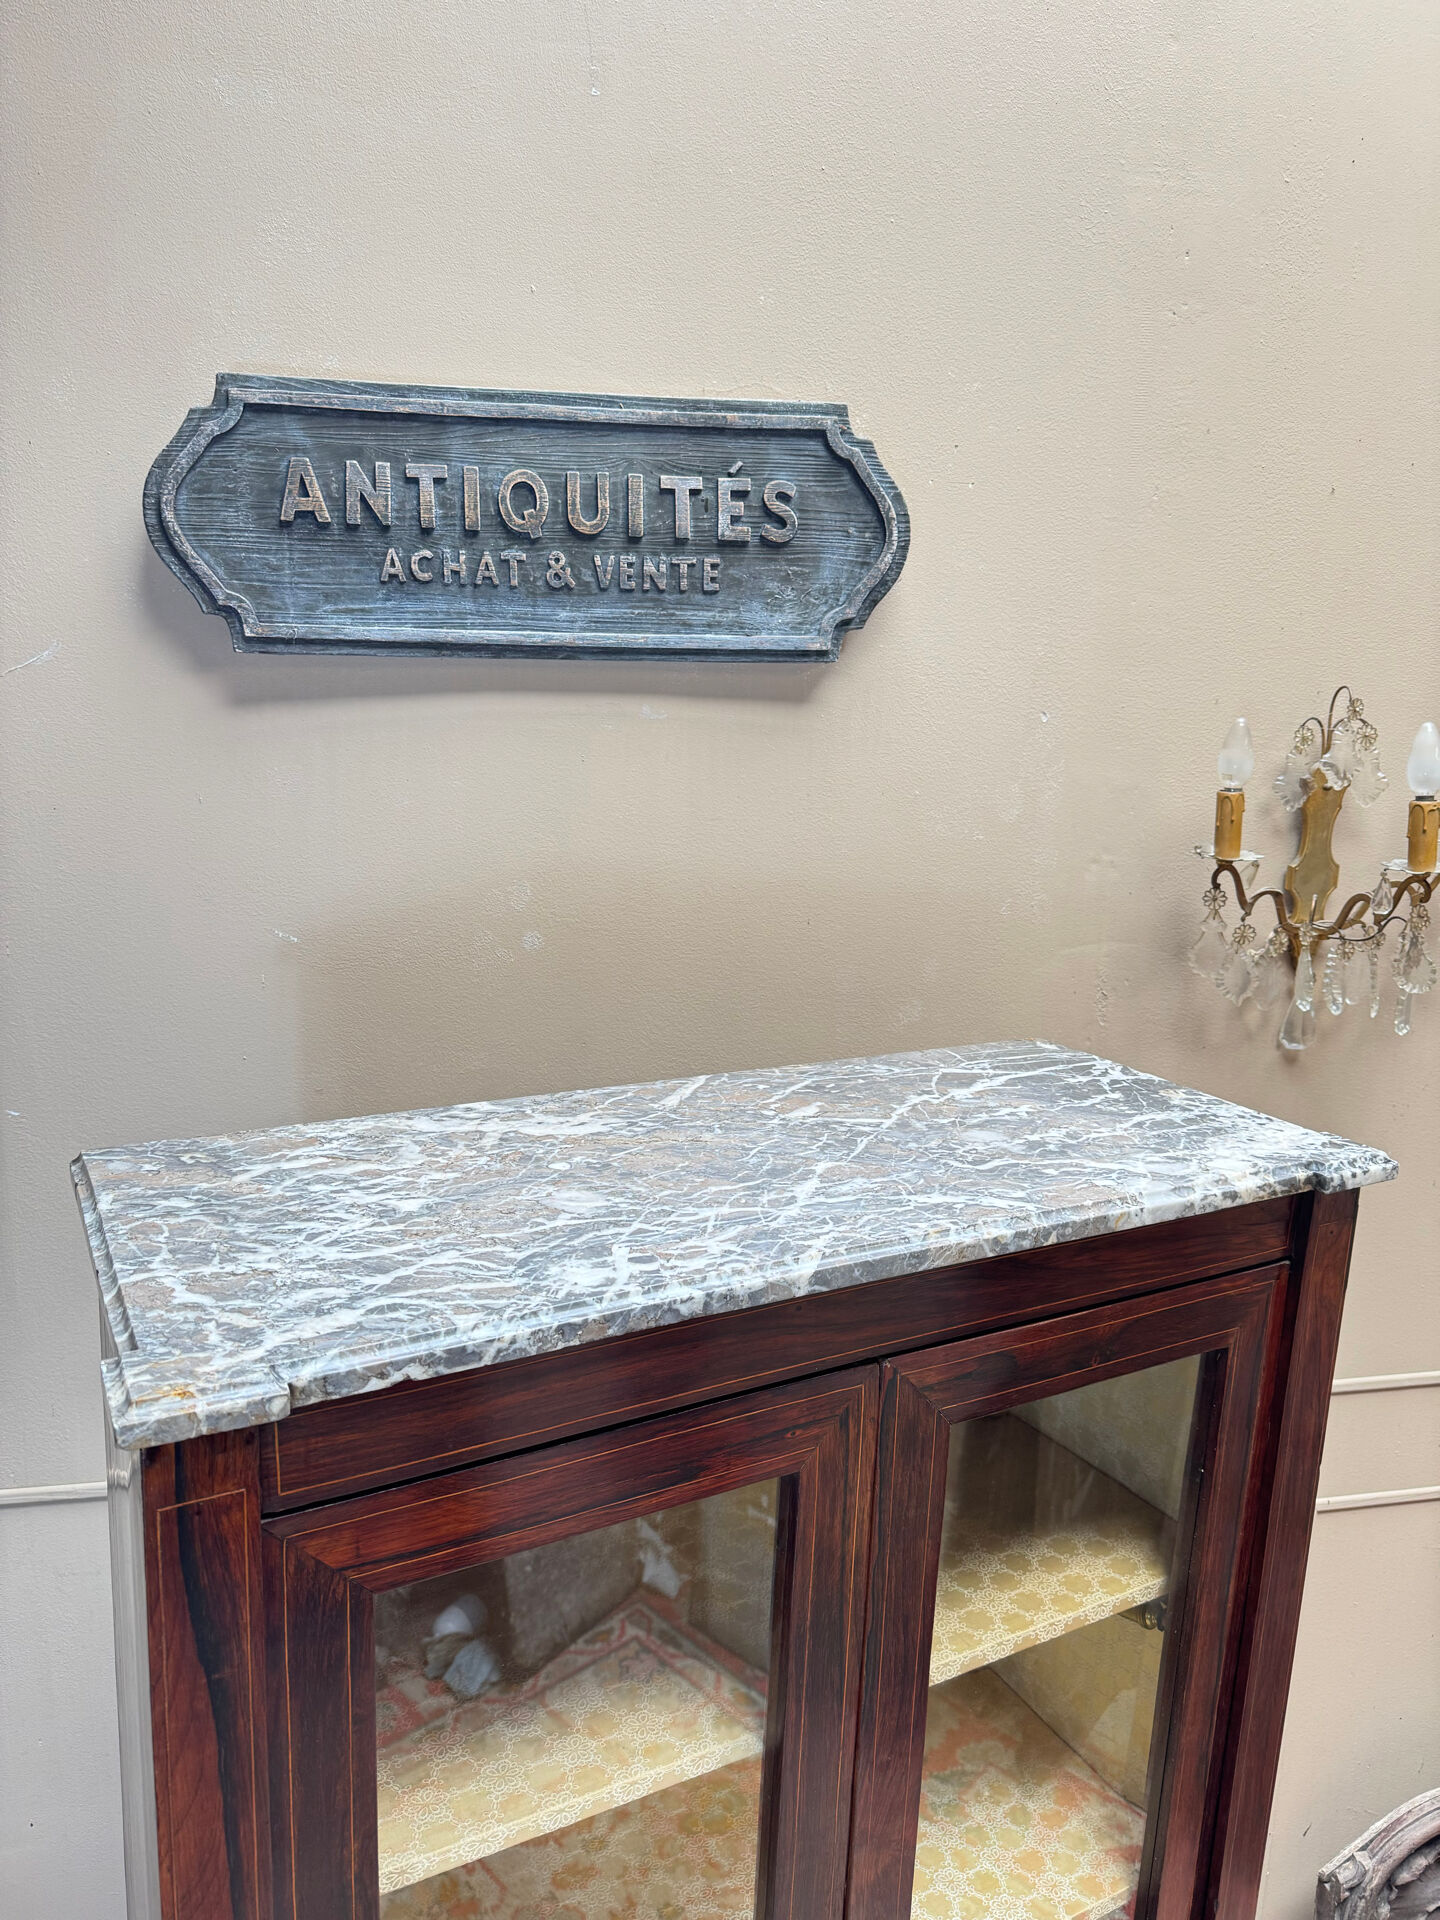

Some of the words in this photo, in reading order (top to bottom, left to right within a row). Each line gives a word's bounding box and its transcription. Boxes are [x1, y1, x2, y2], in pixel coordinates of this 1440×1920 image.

[280, 457, 799, 544] ANTIQUITÉS
[380, 547, 527, 588] ACHAT
[545, 550, 576, 590] &
[593, 553, 722, 593] VENTE
